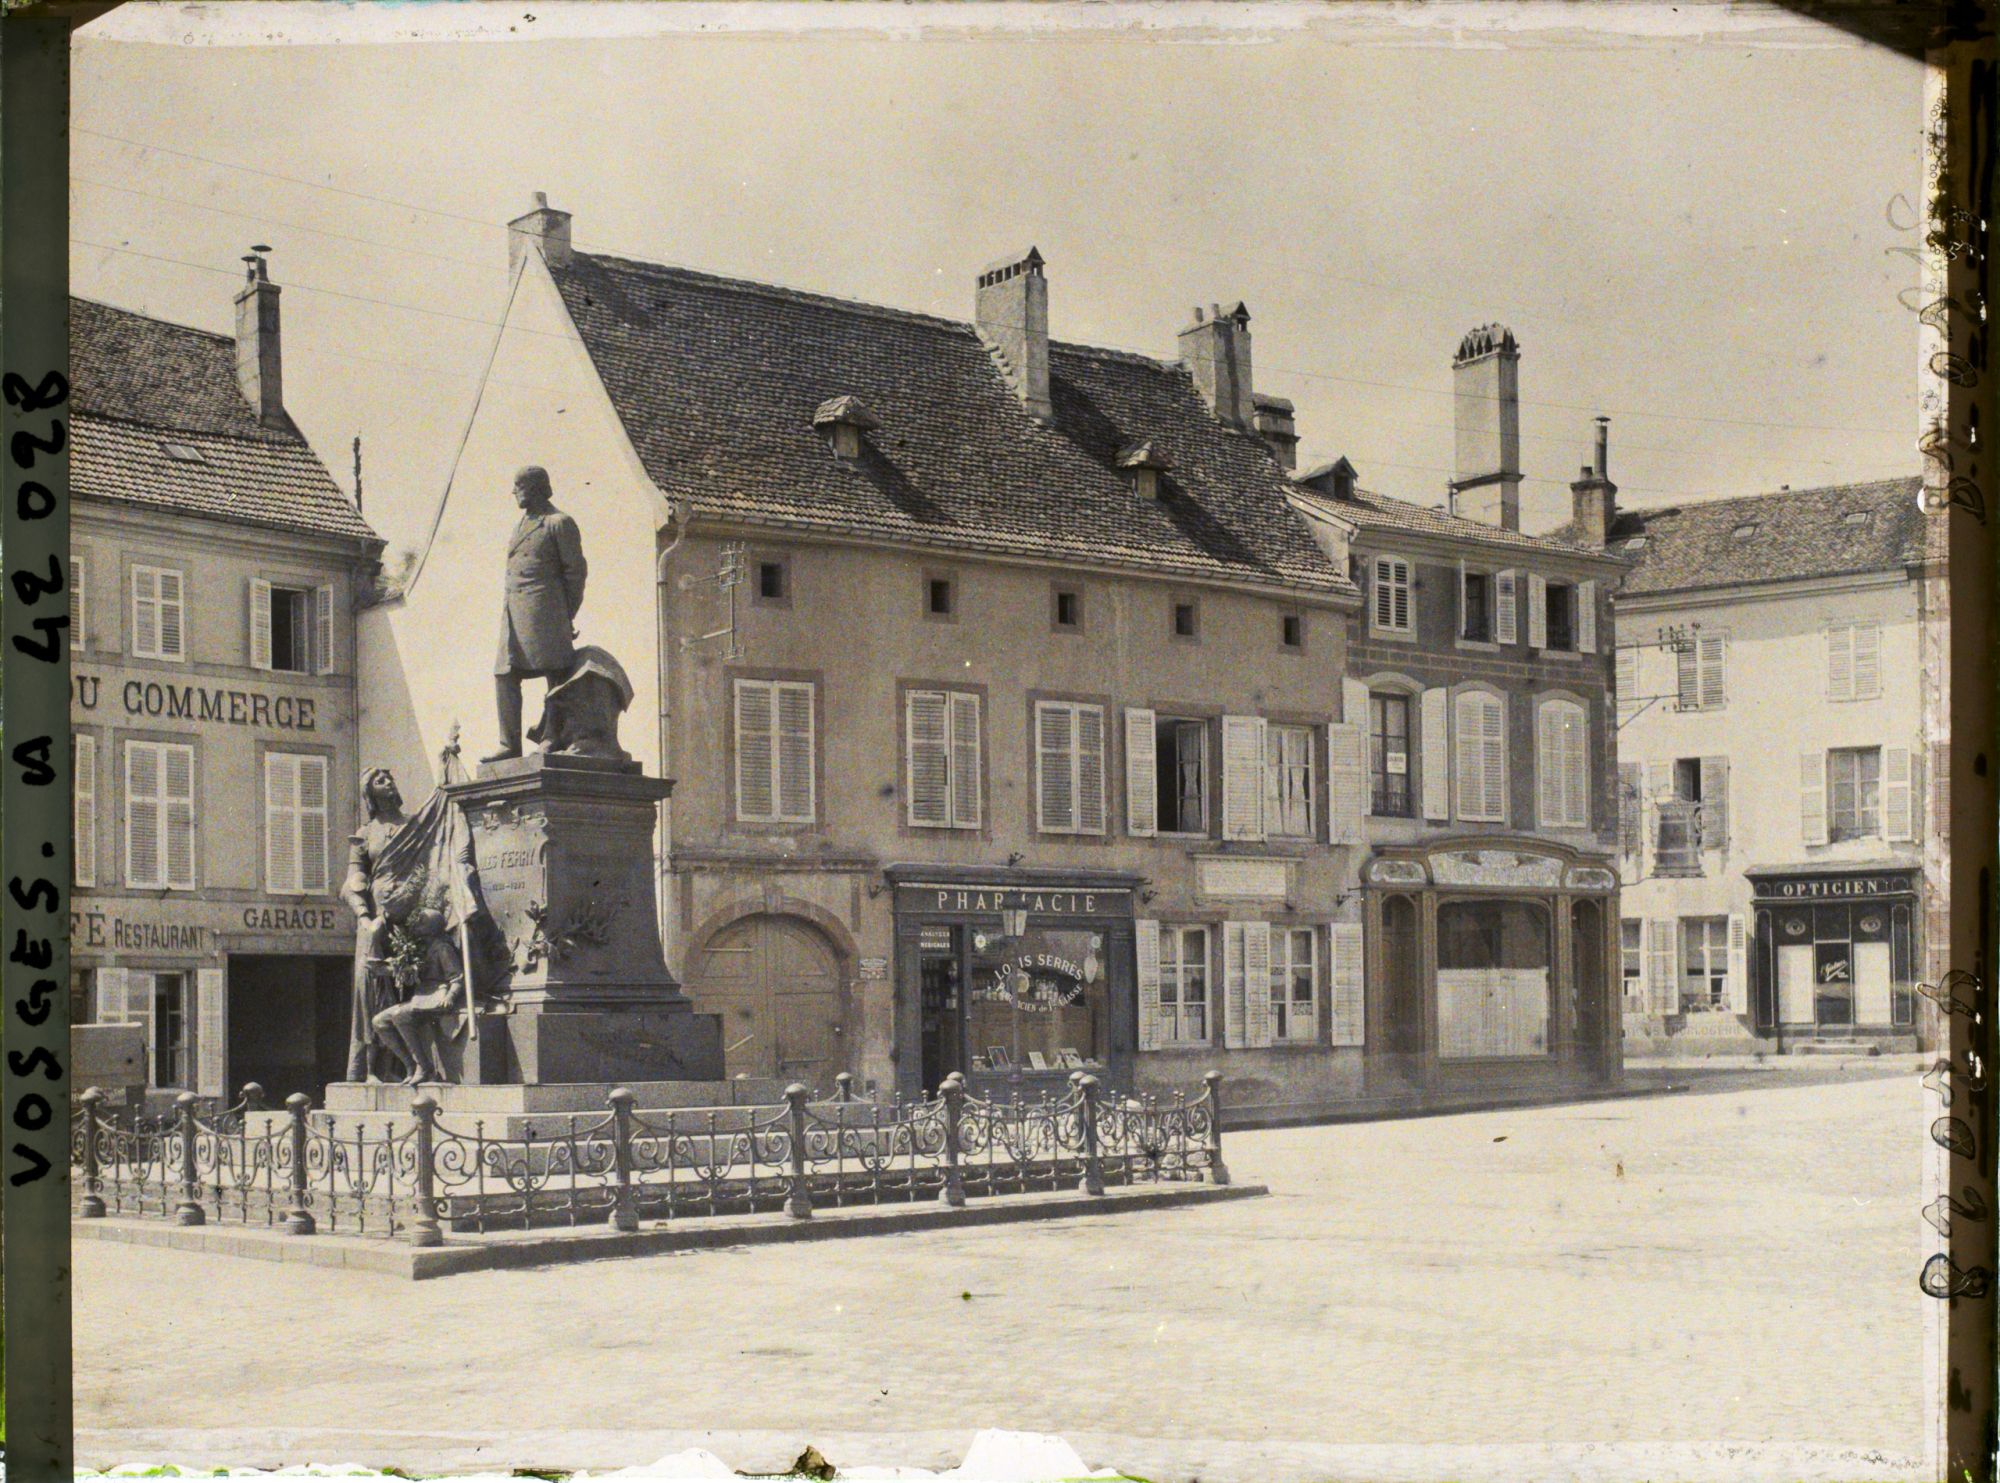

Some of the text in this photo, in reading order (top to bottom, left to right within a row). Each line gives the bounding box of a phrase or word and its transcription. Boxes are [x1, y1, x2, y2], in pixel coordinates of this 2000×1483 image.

[3, 368, 67, 521] 028
[11, 553, 69, 664] 42
[70, 675, 316, 731] U COMMERCE
[938, 891, 1096, 913] PHARACIE
[1783, 880, 1878, 896] OPTICIEN
[114, 918, 205, 950] RESTAURANT
[243, 908, 335, 930] GARAGE
[994, 954, 1032, 981] LOIS
[8, 842, 62, 1187] VOSGES.
